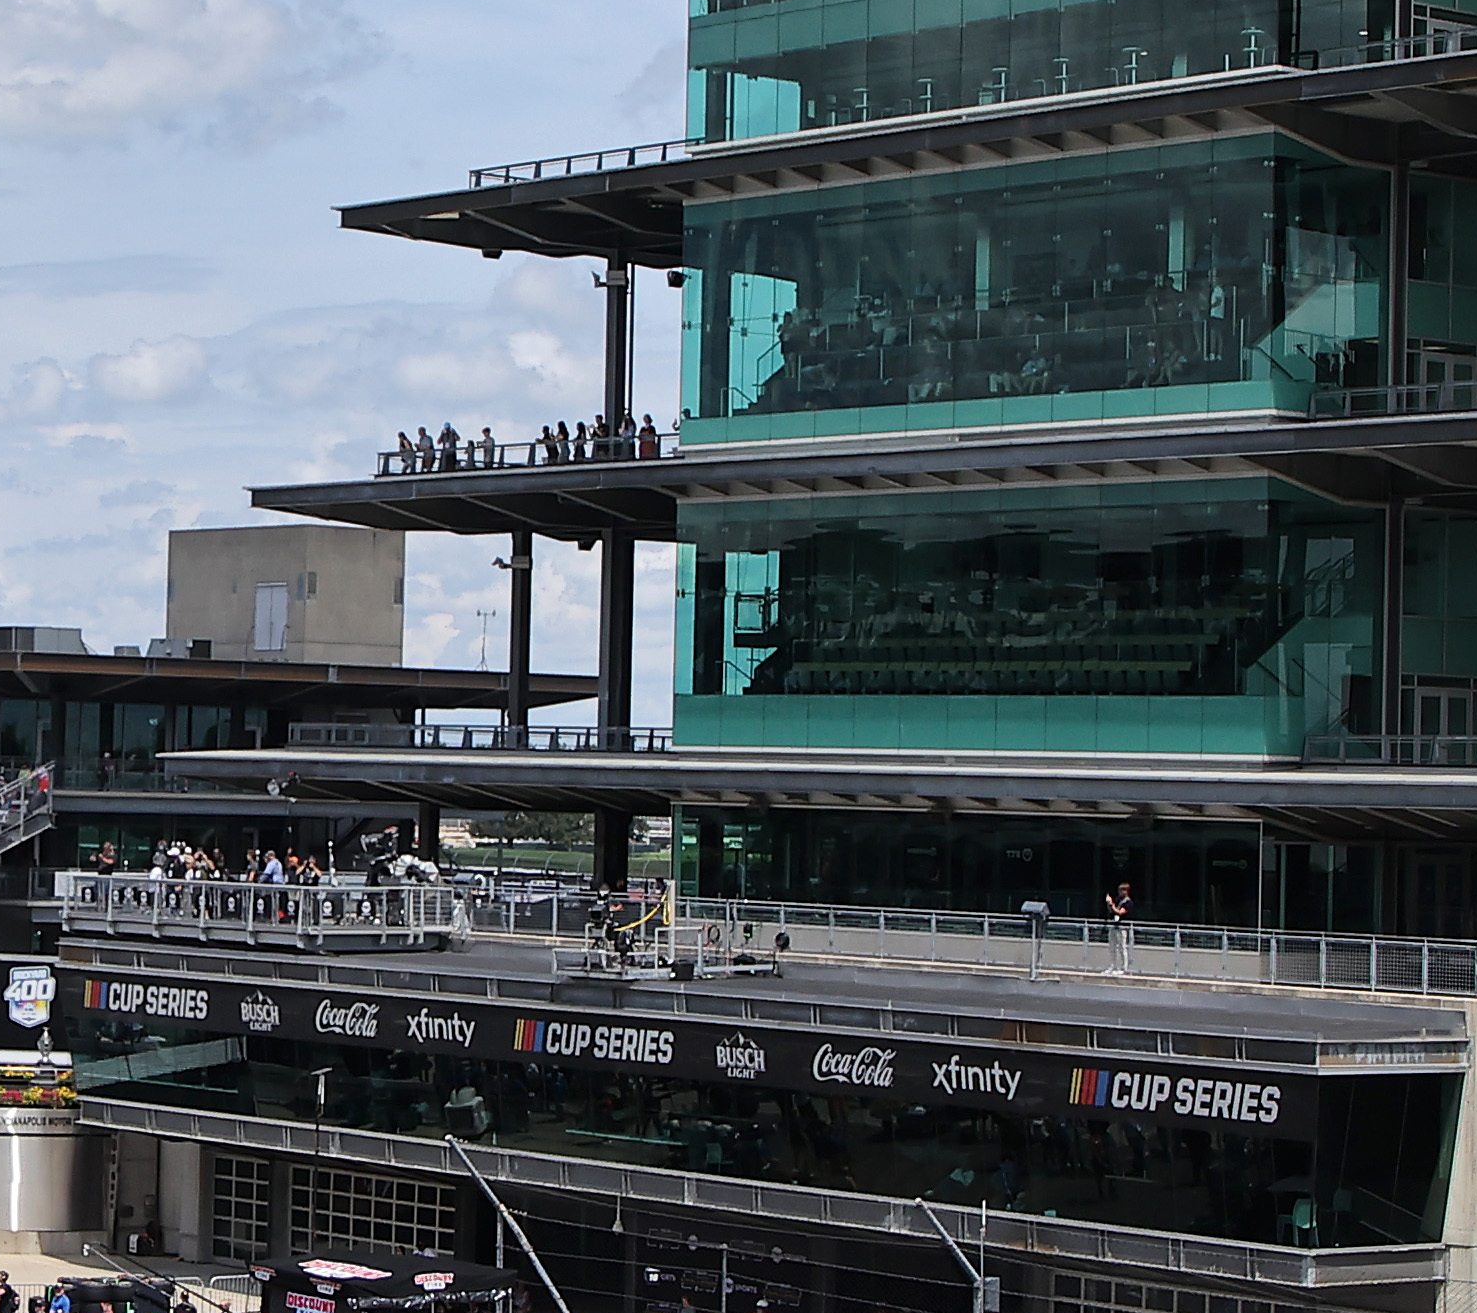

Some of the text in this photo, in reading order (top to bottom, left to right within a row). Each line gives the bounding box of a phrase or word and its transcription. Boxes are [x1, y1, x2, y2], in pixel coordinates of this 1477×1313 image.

[4, 977, 56, 1002] 400
[108, 982, 209, 1020] CUP SERIES
[241, 1002, 280, 1026] BUSCH
[249, 1020, 273, 1031] LIGHT
[406, 1007, 476, 1048] xfinity
[546, 1022, 675, 1065] CUP SERIES
[716, 1042, 766, 1072] BUSCH
[727, 1066, 755, 1079] LIGHT
[931, 1054, 1024, 1101] xfinity
[1111, 1071, 1281, 1125] CUP SERIES
[0, 1116, 46, 1127] INIANAPOLIS
